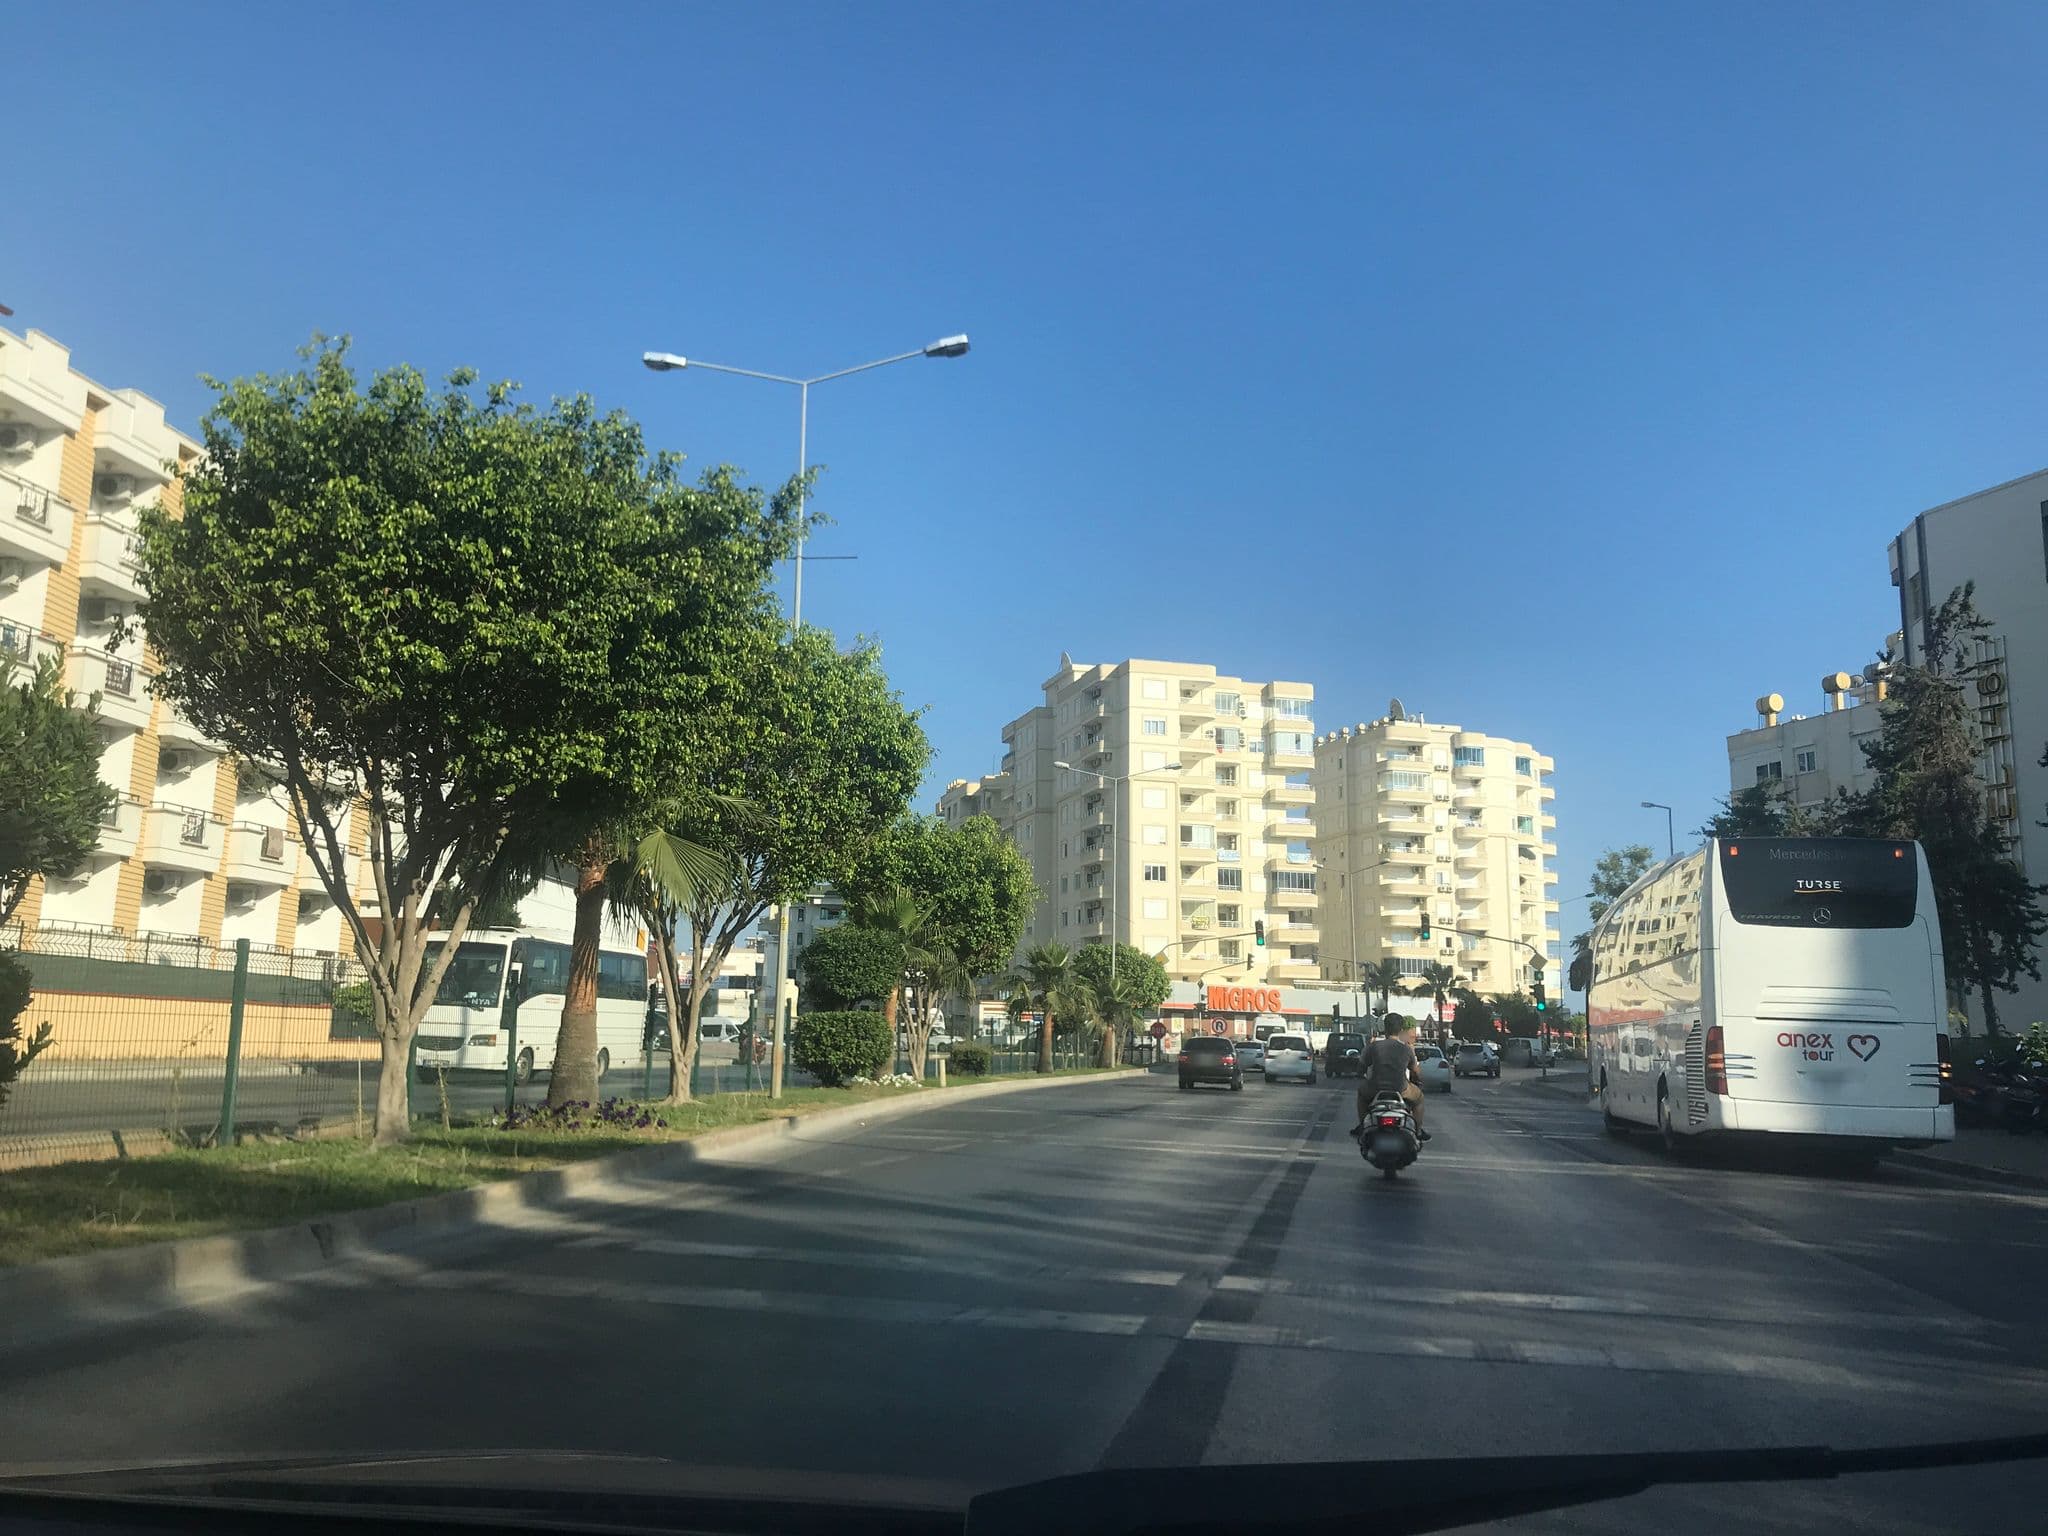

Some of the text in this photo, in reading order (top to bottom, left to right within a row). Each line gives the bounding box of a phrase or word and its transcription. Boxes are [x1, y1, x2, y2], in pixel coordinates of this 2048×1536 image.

[1796, 880, 1841, 889] TURSE
[1776, 1033, 1834, 1049] anex
[1802, 1050, 1834, 1061] tour
